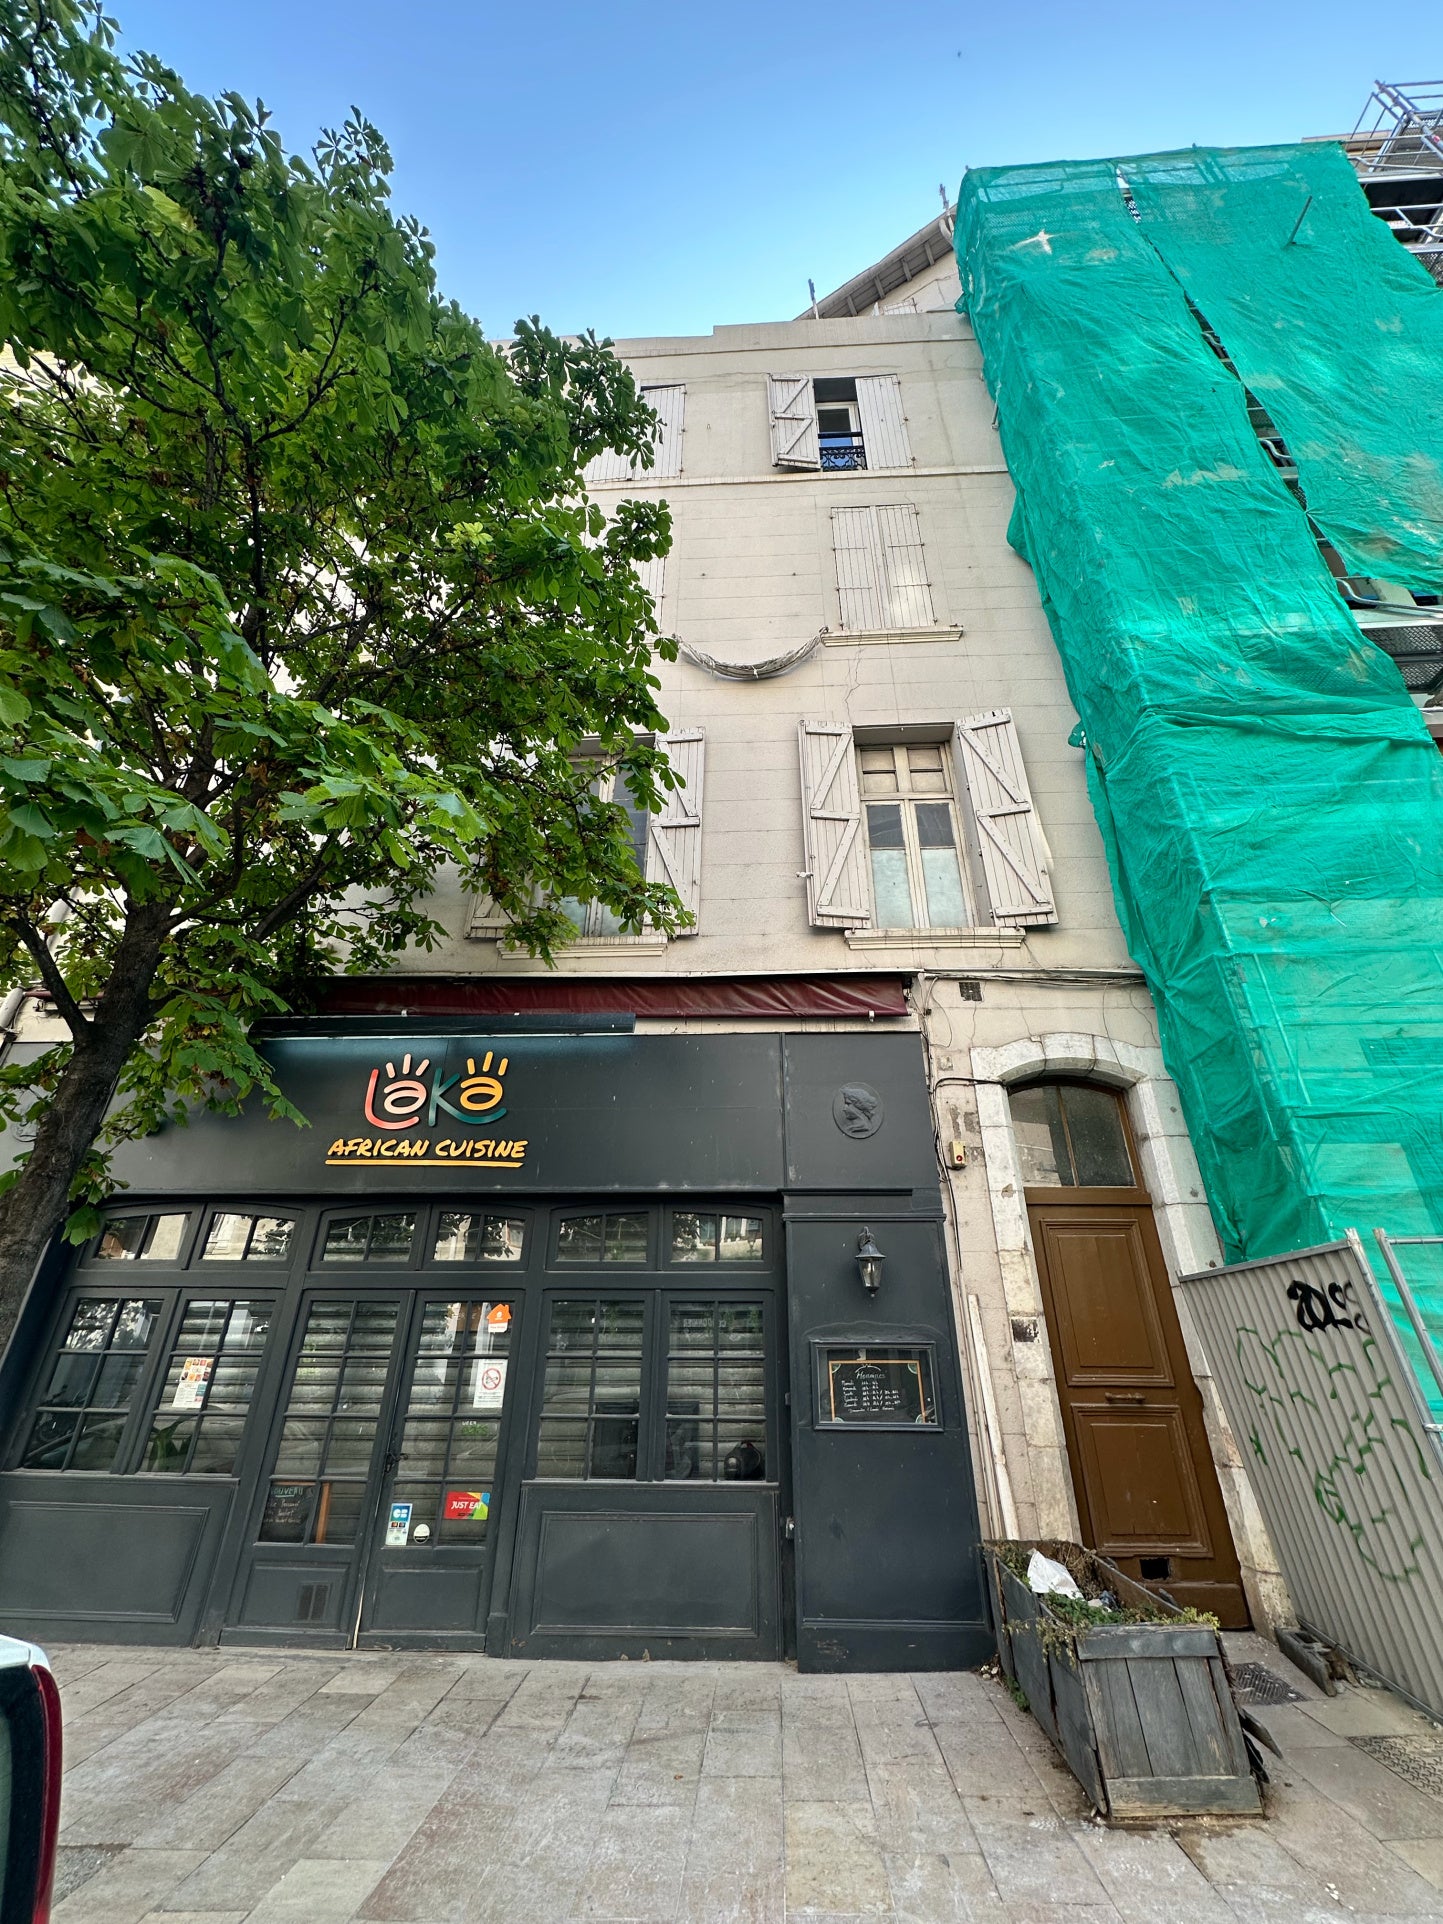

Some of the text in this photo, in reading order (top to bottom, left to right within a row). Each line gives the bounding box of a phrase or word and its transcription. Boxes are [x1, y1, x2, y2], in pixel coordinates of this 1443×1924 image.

[327, 1137, 529, 1159] AFRICAN CUISINE
[450, 1500, 482, 1510] JUST EAT
